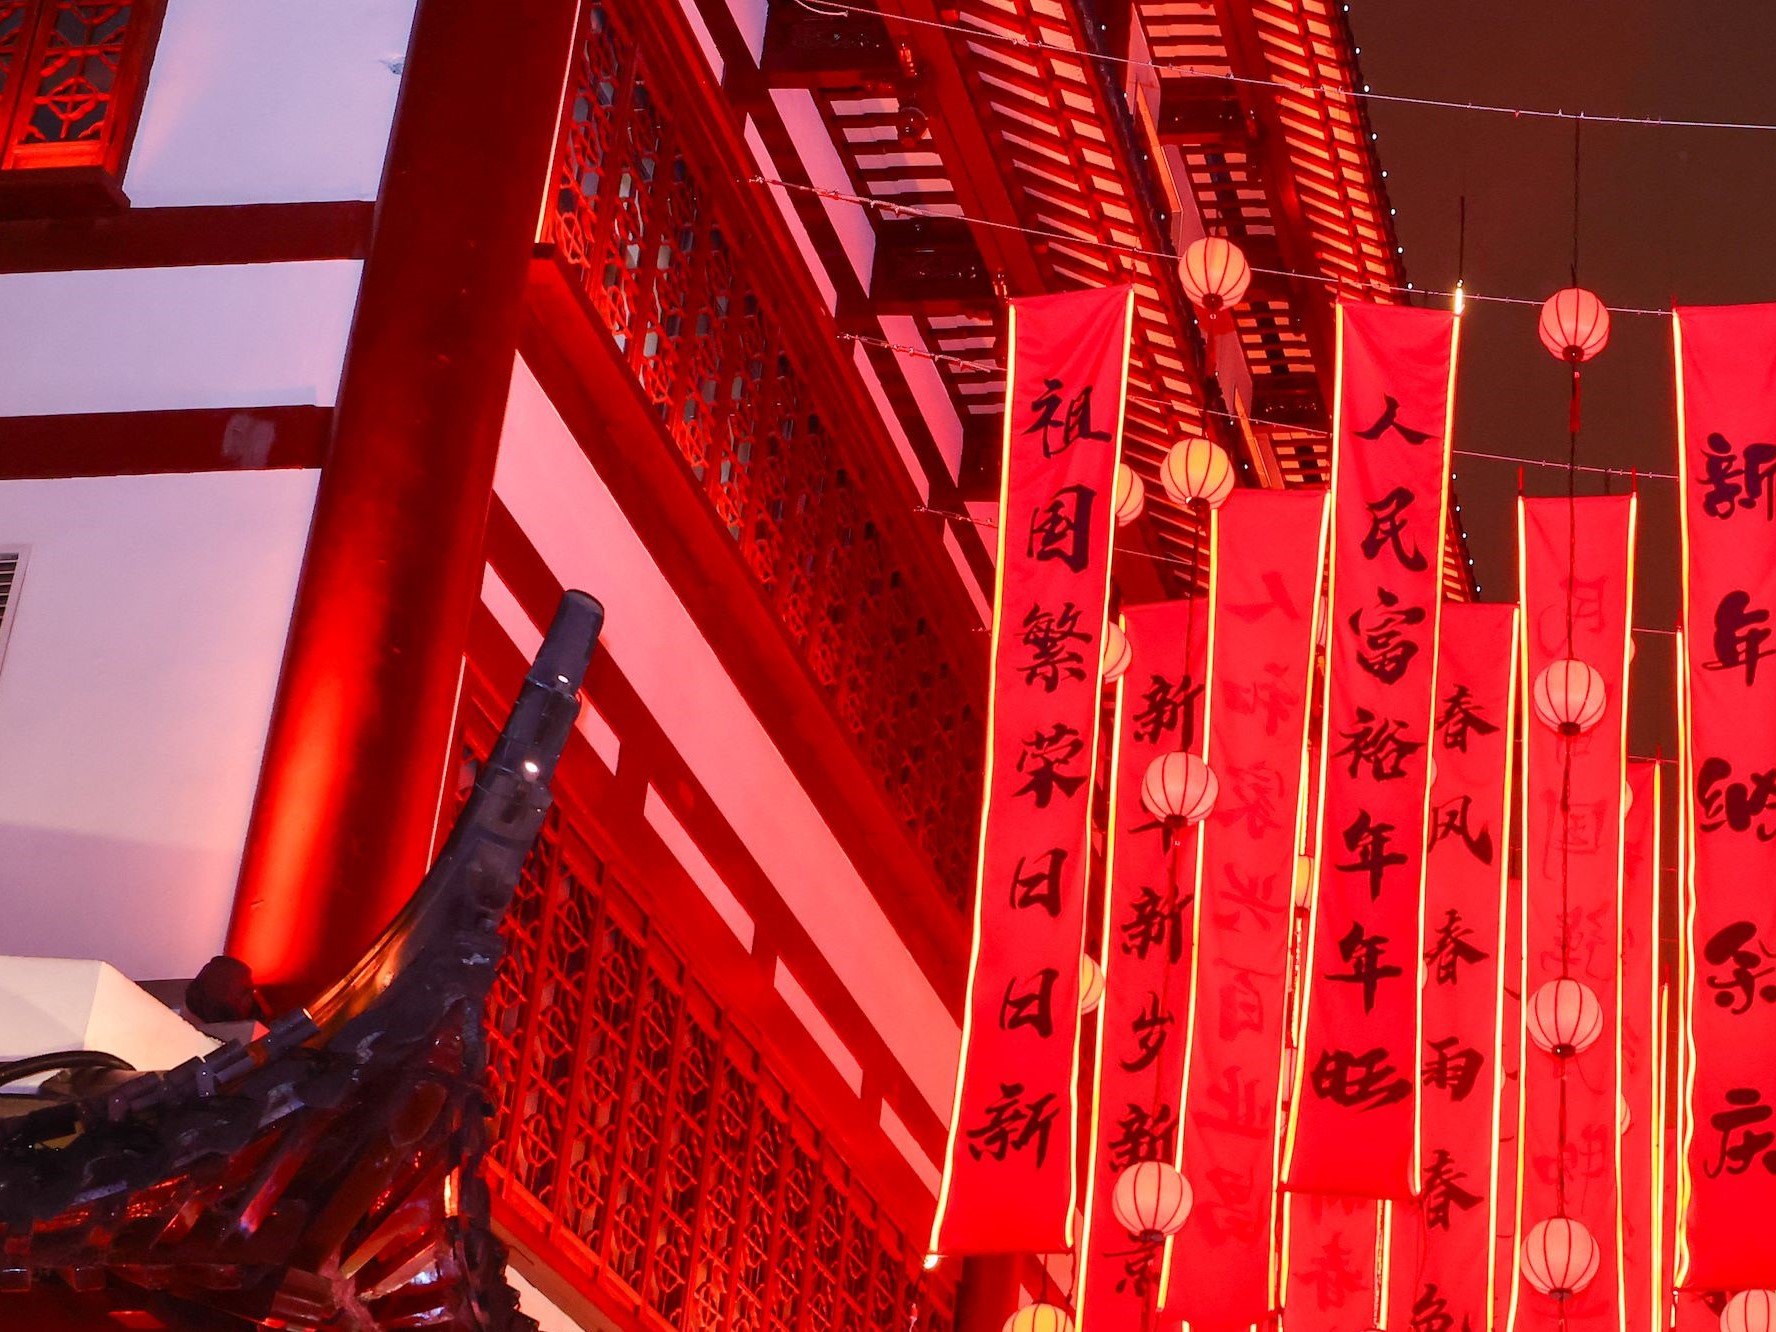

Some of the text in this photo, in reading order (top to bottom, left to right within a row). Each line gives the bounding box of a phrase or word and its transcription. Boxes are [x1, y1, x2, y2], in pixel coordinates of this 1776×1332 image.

[967, 378, 1112, 1169] 祖国繁荣日日新
[1311, 395, 1440, 1111] 人民富裕年年旺
